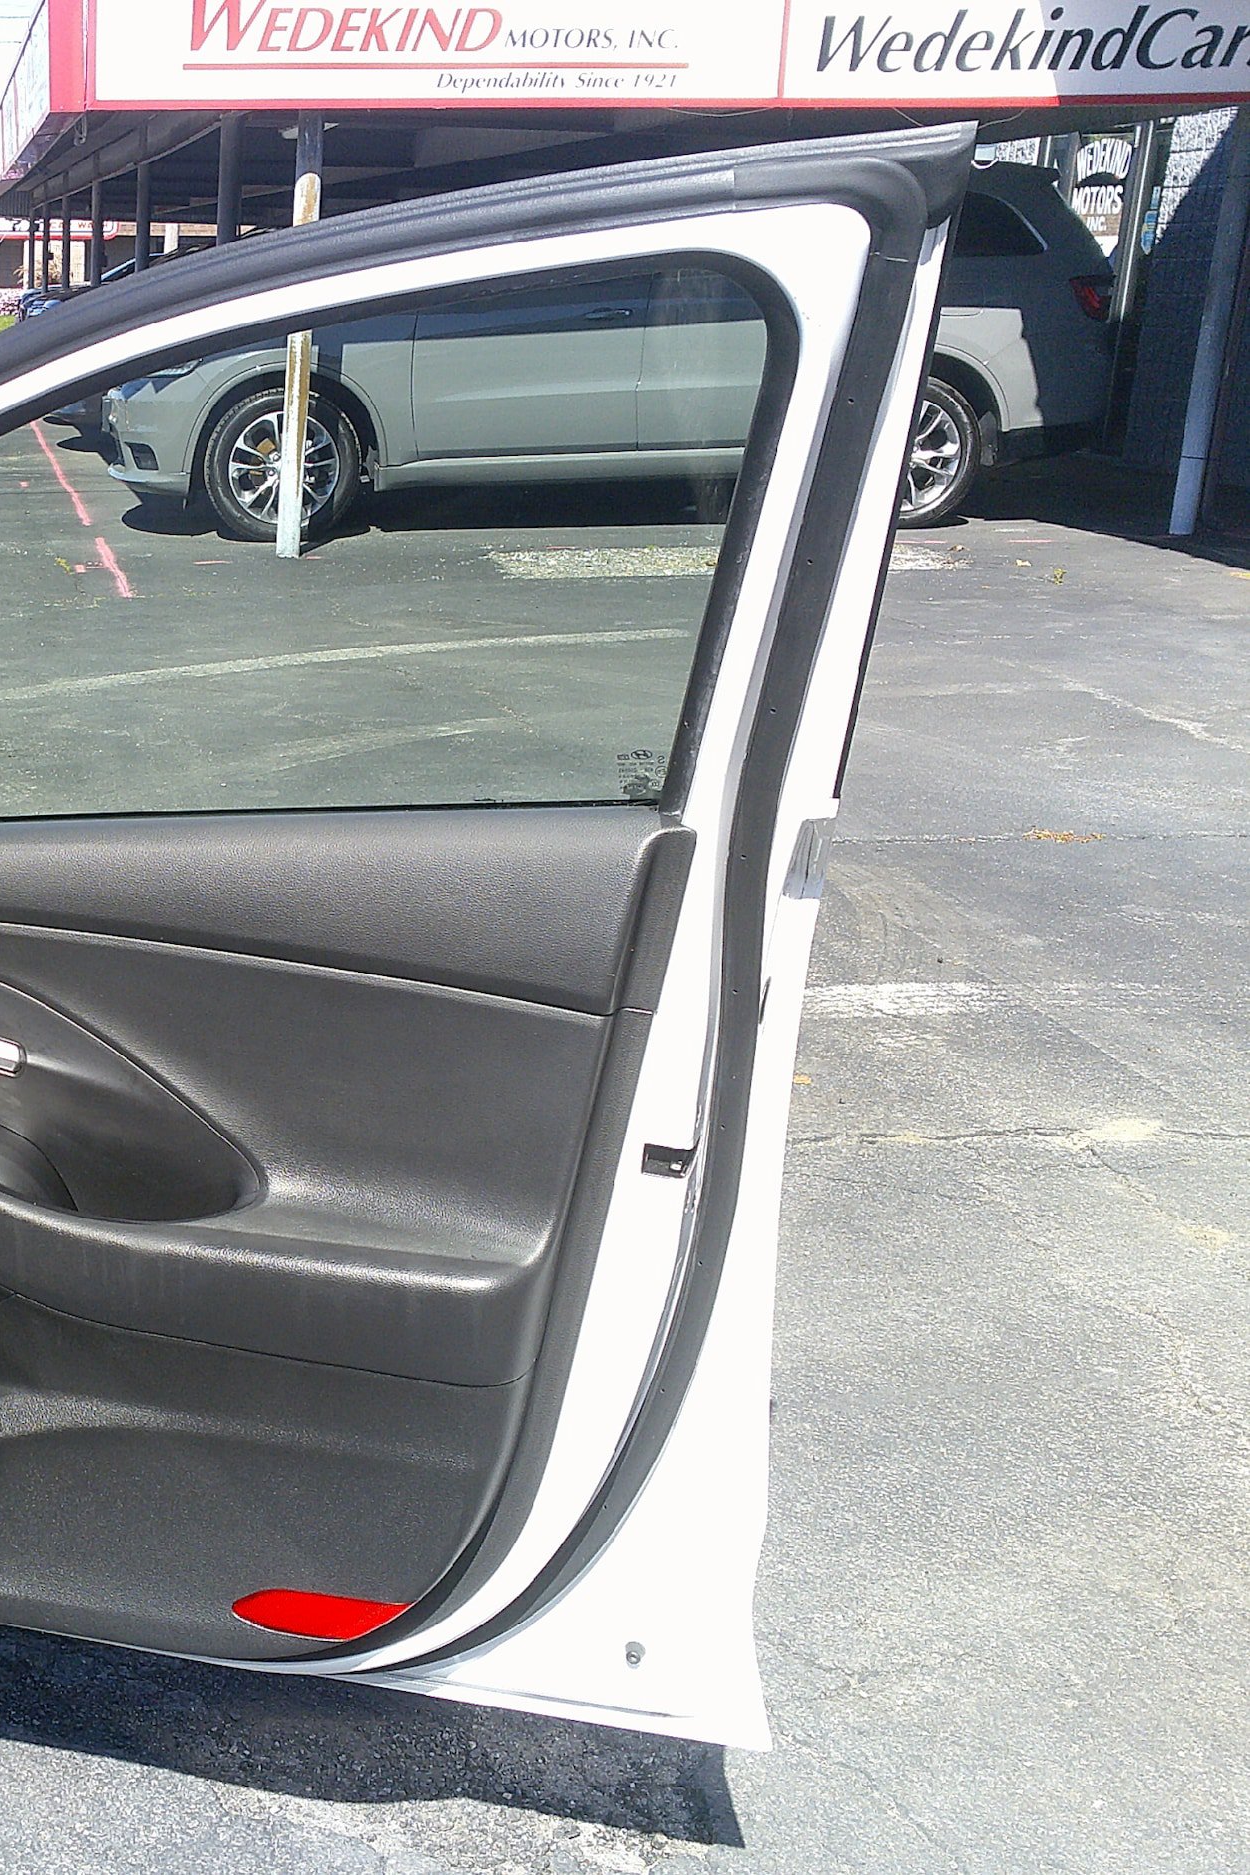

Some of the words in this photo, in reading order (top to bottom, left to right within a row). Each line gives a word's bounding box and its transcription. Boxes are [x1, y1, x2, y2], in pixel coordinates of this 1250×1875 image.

[190, 0, 503, 51] WEDEKIND
[504, 28, 618, 50] MOTORS,
[628, 29, 678, 48] INC.
[816, 5, 1250, 72] WedekindCar
[436, 71, 566, 93] Dependability
[575, 71, 625, 88] Since
[633, 73, 677, 88] 1921
[1076, 137, 1132, 182] WEDEKIND
[1071, 184, 1124, 215] MOTORS
[1086, 215, 1107, 232] INC.
